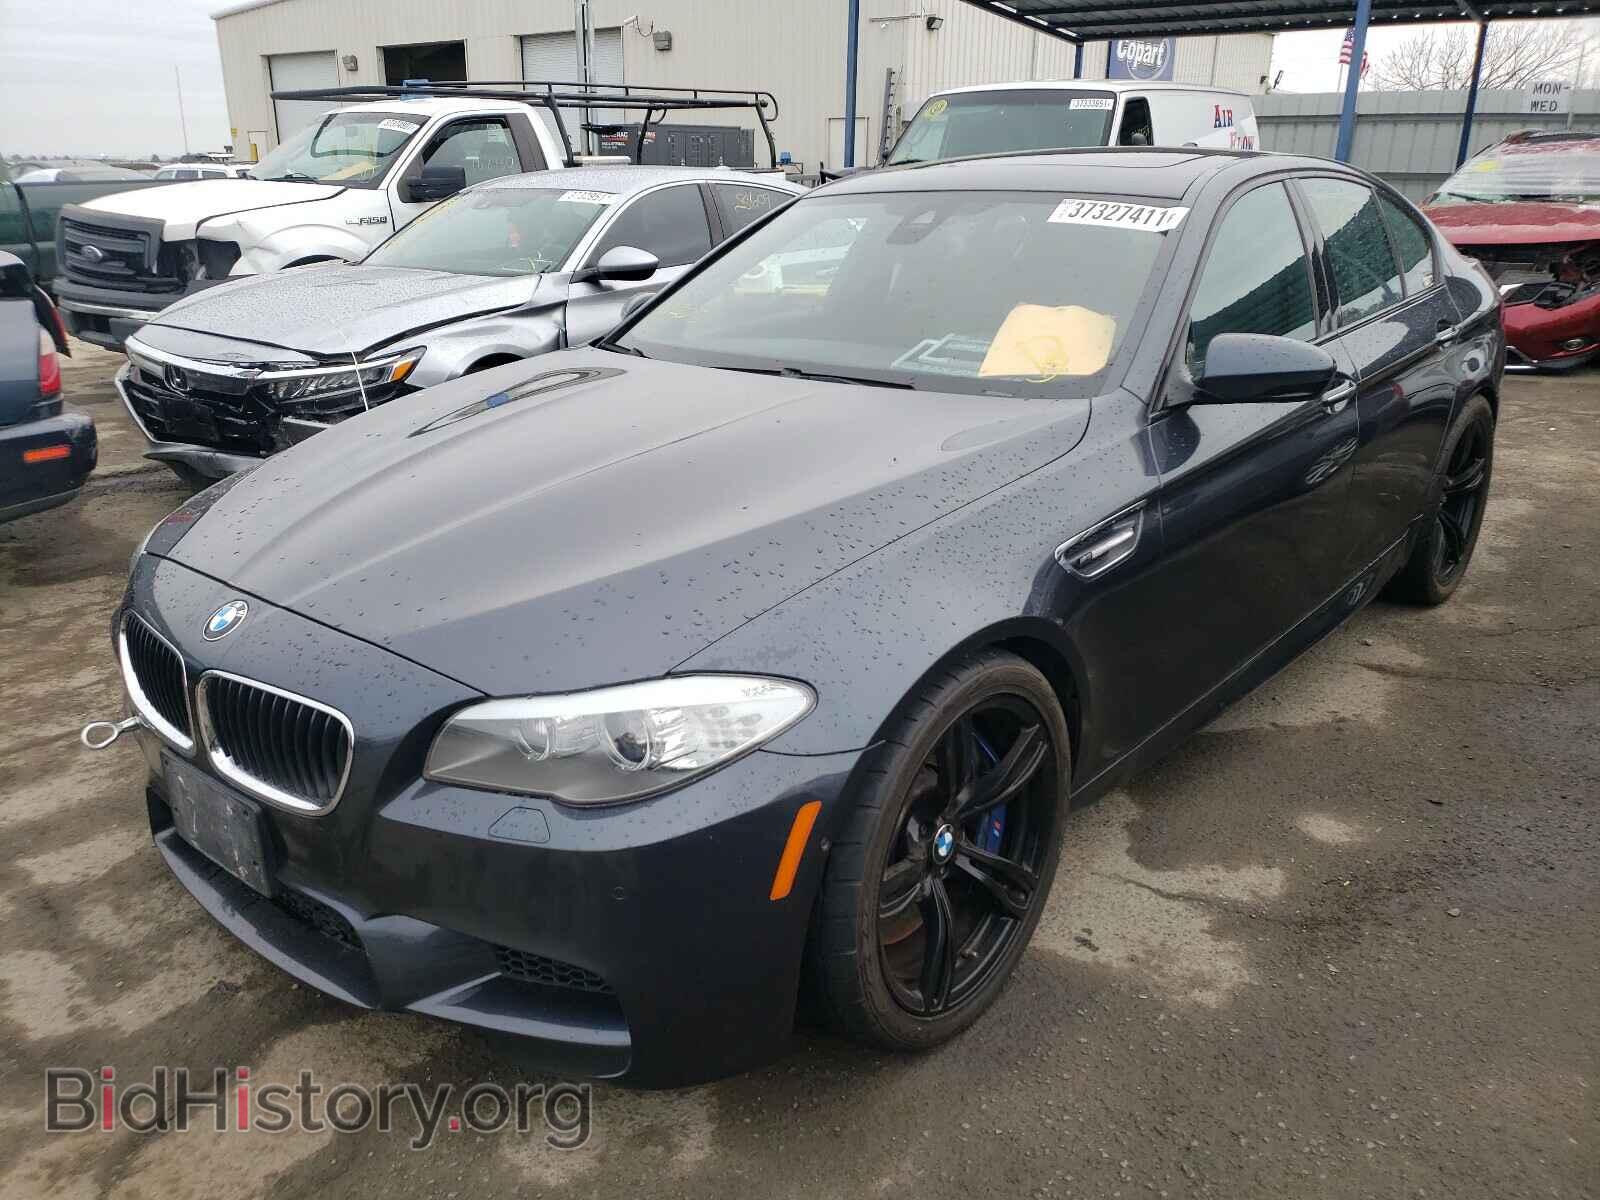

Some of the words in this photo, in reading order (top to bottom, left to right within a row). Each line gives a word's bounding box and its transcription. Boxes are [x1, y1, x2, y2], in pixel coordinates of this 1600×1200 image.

[1117, 39, 1165, 69] Copart
[1530, 100, 1558, 112] WED
[1068, 201, 1169, 227] 37327411
